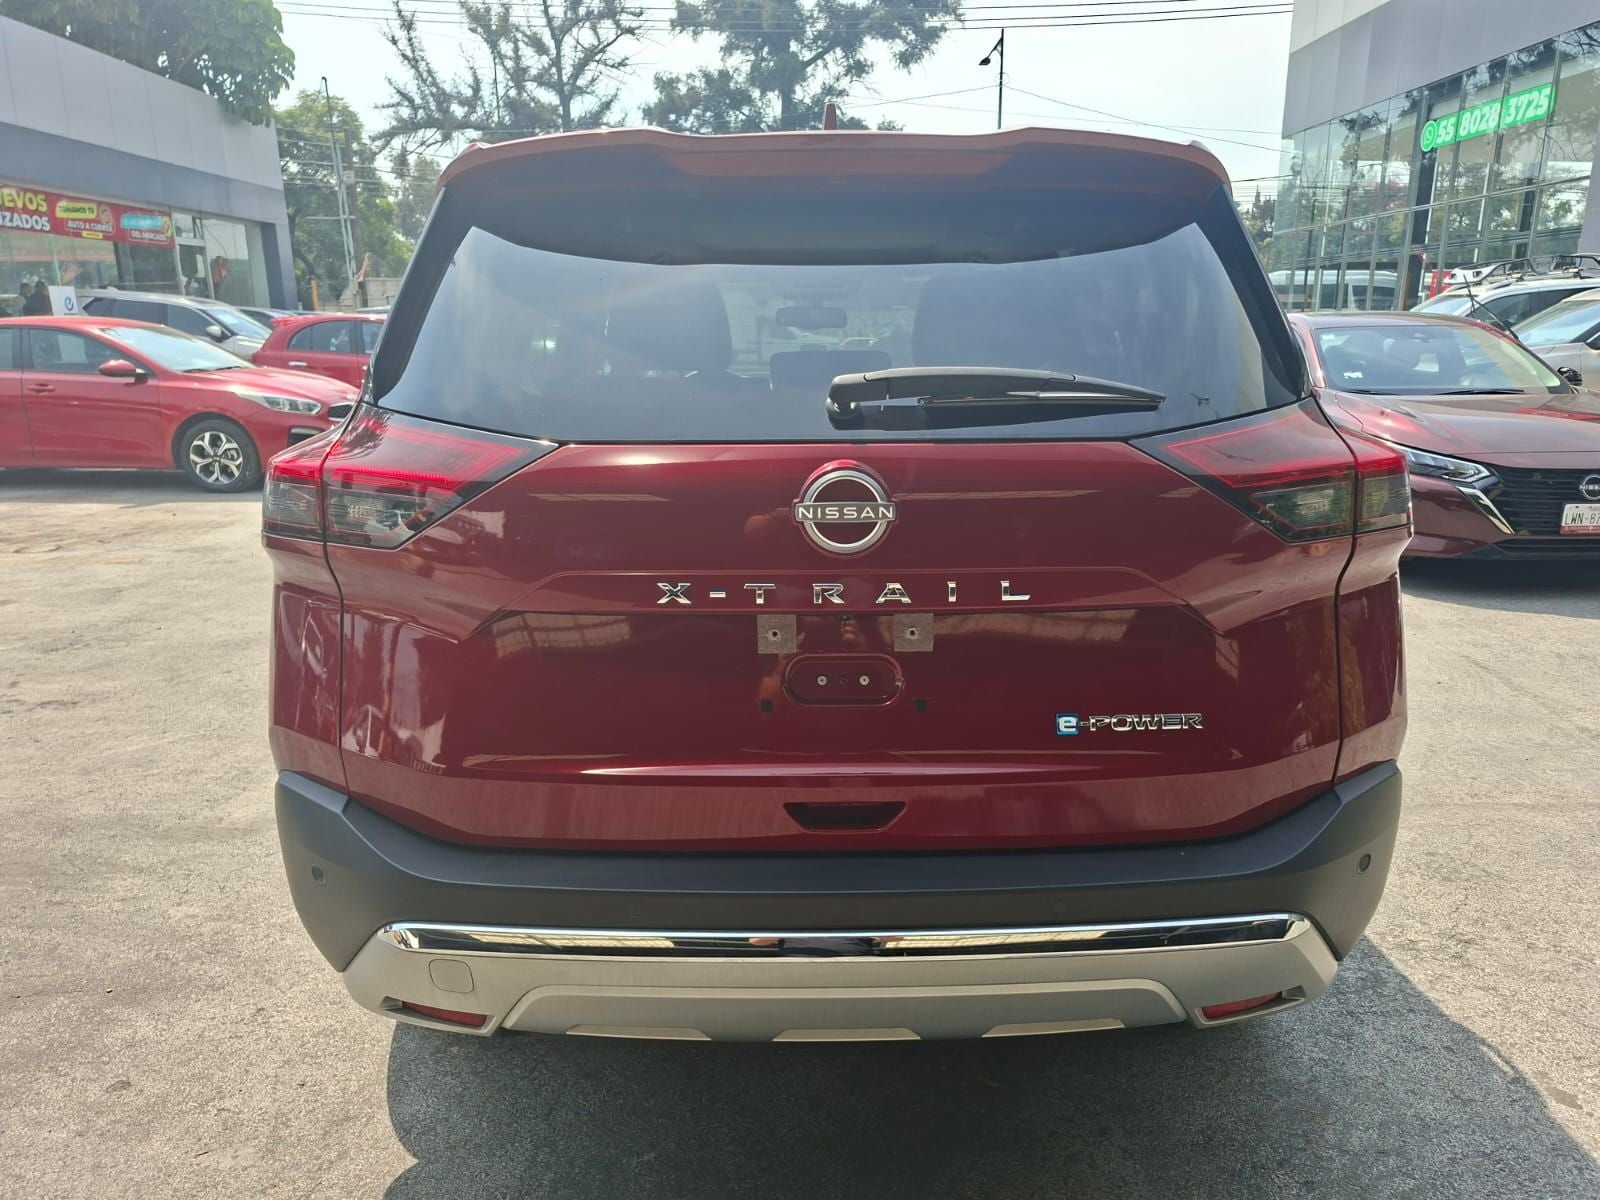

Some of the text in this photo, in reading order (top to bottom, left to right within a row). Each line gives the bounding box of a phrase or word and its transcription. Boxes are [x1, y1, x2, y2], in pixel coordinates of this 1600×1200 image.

[1436, 87, 1551, 144] 55 8028 3725
[0, 188, 48, 212] EVOS
[798, 506, 893, 519] NISSAN
[656, 580, 1031, 605] X-TRAIL
[1056, 713, 1204, 735] e-POWER
